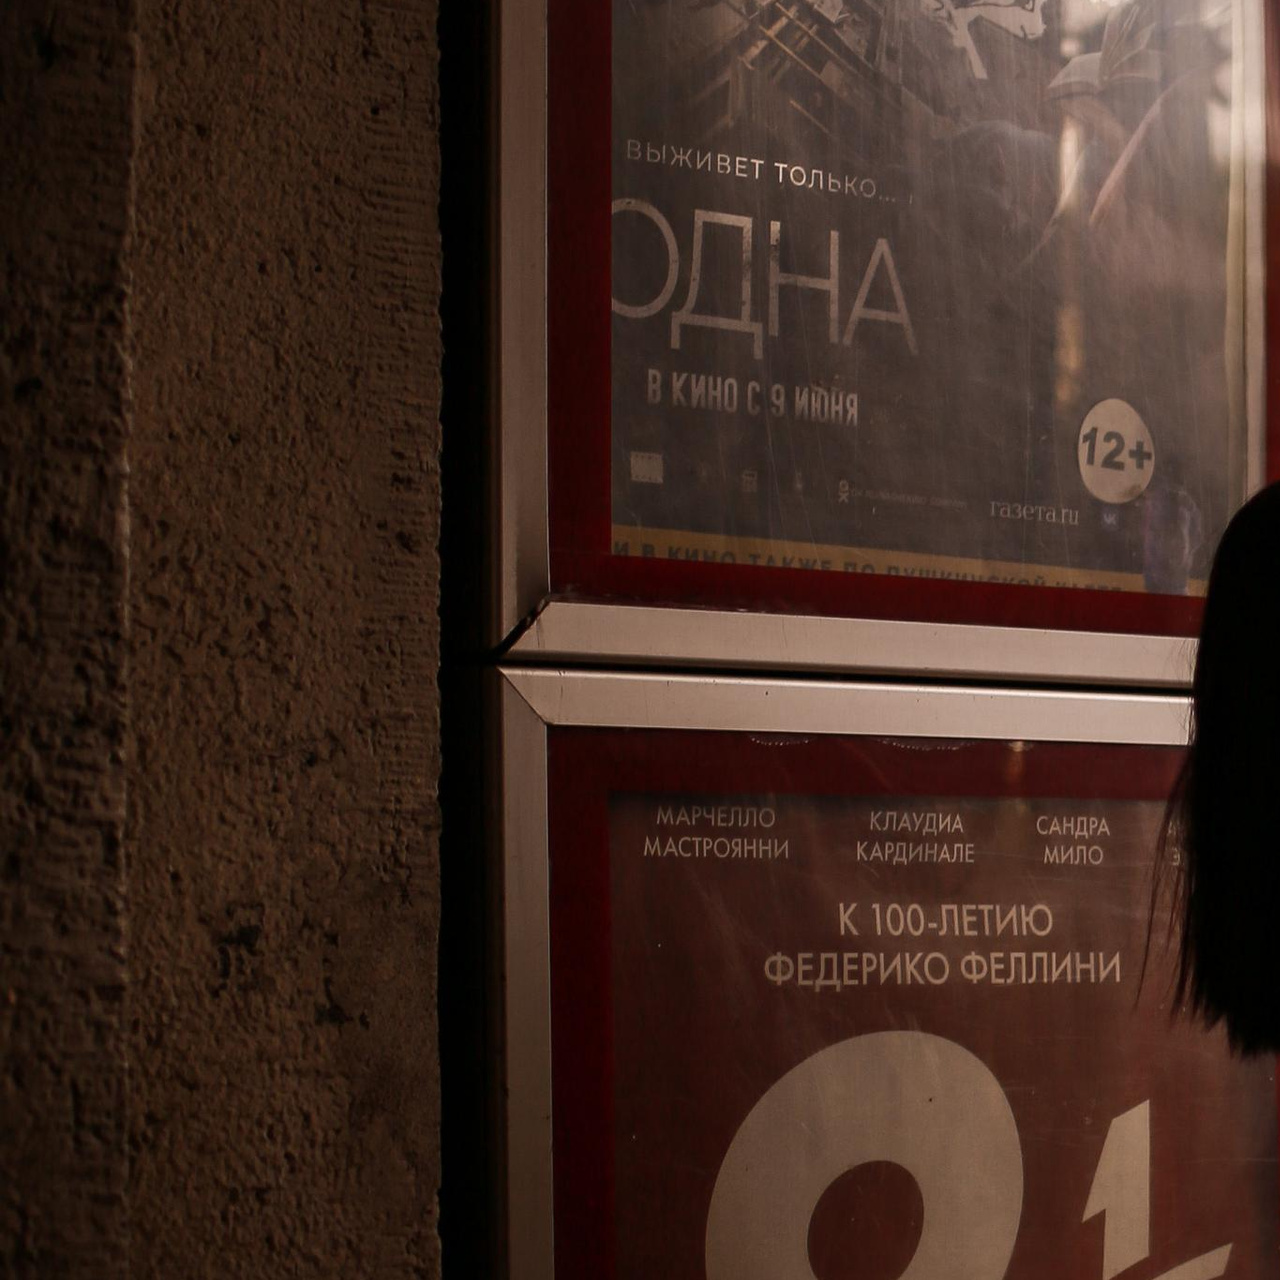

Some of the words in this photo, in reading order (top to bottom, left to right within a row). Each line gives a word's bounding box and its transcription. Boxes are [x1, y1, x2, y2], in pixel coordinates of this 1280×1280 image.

[625, 138, 766, 182] ВЫЖИВЕТ
[611, 197, 919, 360] ОДНА
[647, 368, 662, 405] В
[671, 372, 738, 413] КИНО
[746, 377, 760, 416] С
[771, 384, 785, 418] 9
[794, 386, 859, 426] ИЮНЯ
[1081, 426, 1152, 471] 12+
[656, 805, 776, 829] МАРЧЕЛЛО
[869, 810, 964, 835] КЛАУДИА
[1036, 815, 1111, 839] САНДРА
[643, 836, 789, 859] МАСТРОЯННИ
[856, 840, 975, 866] КАРДИНАЛЕ
[1043, 845, 1104, 866] МИЛО
[839, 902, 859, 937] К
[871, 902, 1054, 937] 100-ЛЕТИЮ
[764, 950, 950, 993] ФЕДЕРИКО
[960, 950, 1121, 985] ФЕЛЛИНИ
